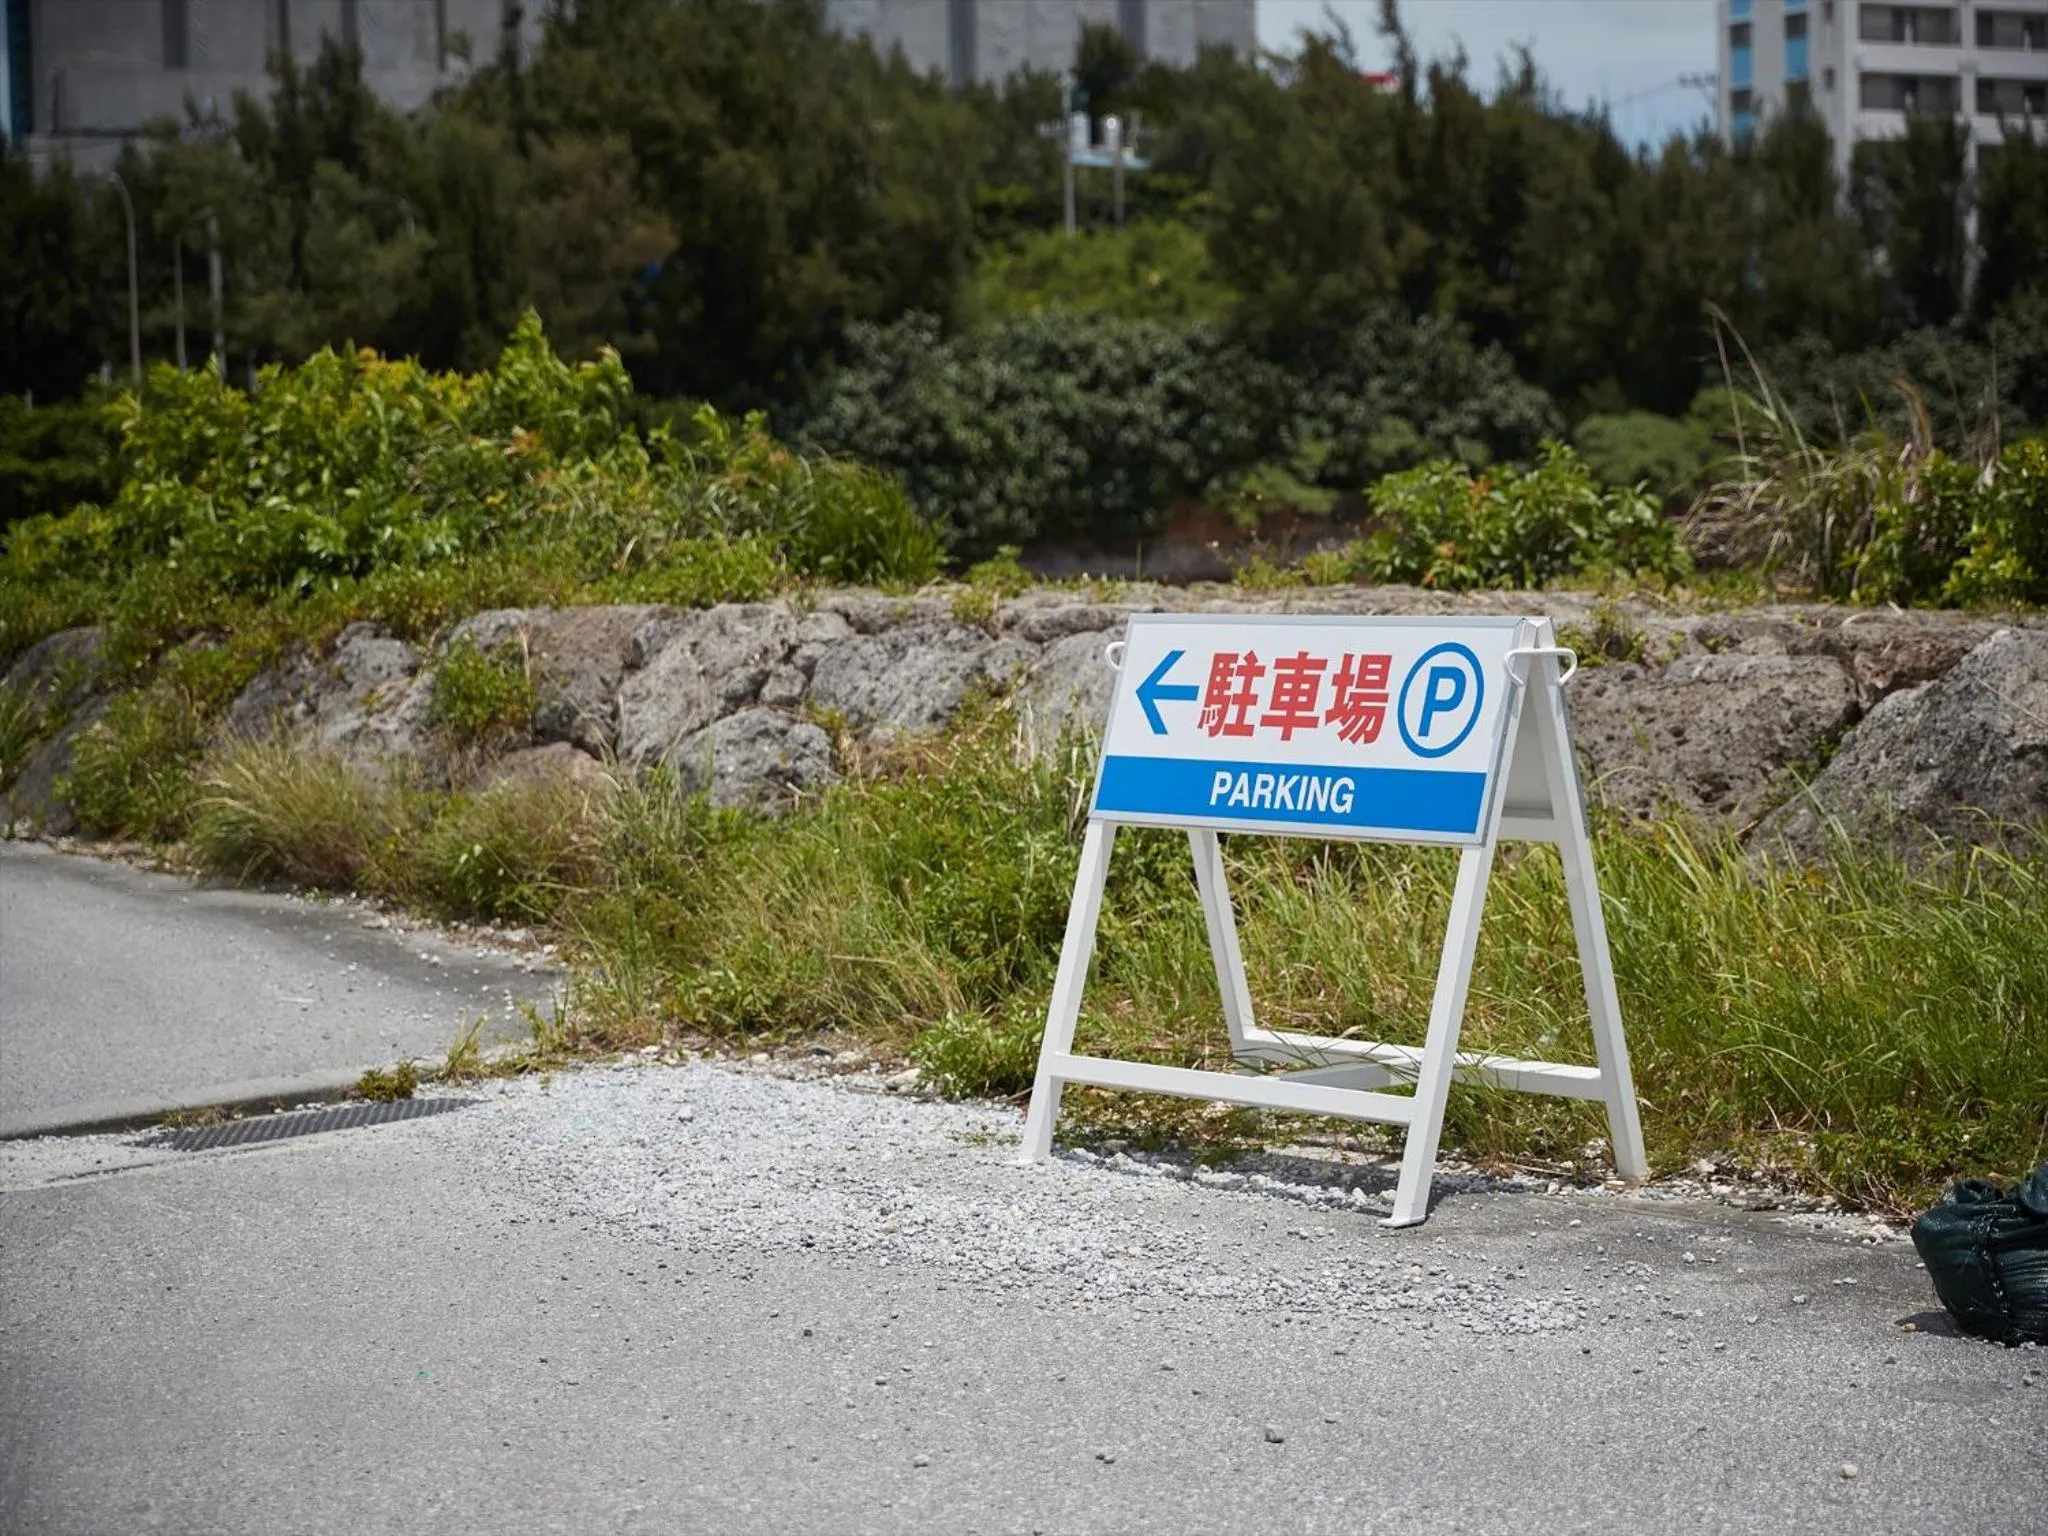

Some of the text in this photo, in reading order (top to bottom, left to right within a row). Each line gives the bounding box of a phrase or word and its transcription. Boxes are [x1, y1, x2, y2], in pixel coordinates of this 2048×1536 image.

[1198, 650, 1467, 744] 駐車場 P
[1209, 771, 1356, 814] PARKING
